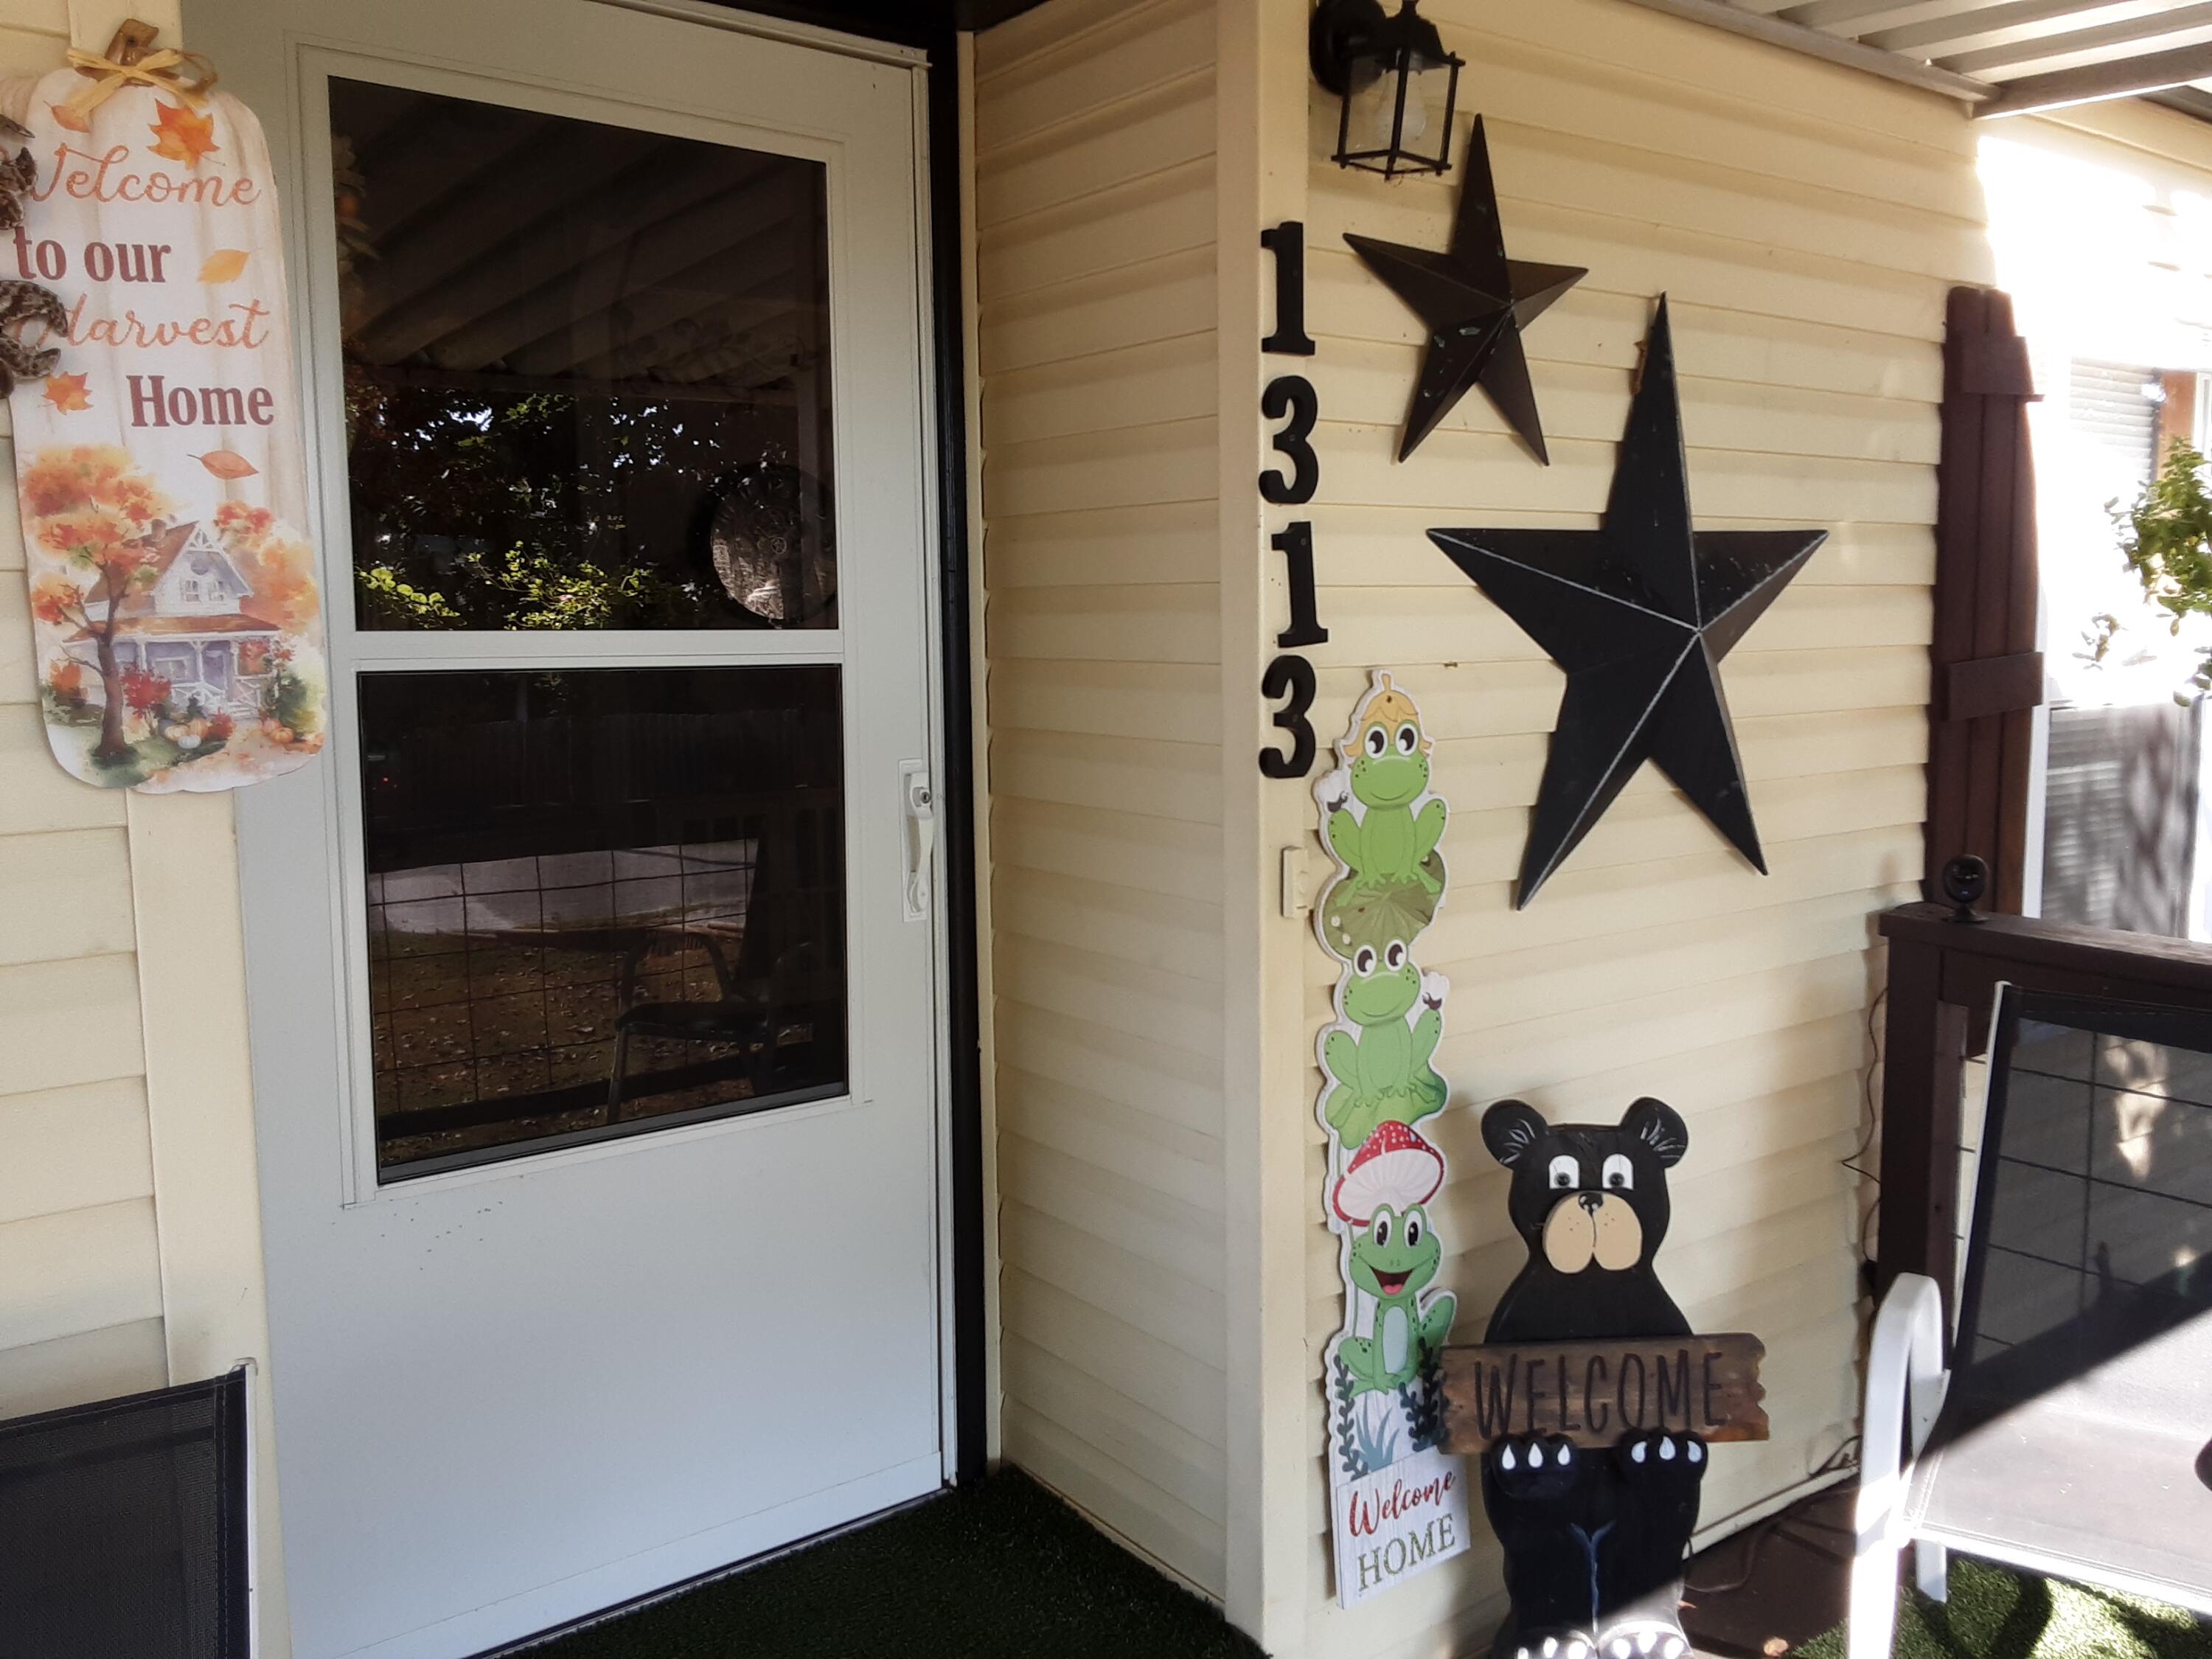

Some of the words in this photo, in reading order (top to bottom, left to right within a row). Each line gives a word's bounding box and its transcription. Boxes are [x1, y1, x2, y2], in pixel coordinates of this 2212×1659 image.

[13, 226, 68, 281] to
[83, 240, 172, 283] our
[126, 375, 274, 428] Home
[1258, 221, 1329, 779] 1313
[1474, 1349, 1728, 1440] WELCOME
[1349, 1469, 1456, 1538] Welcome
[1357, 1513, 1455, 1592] HOME
